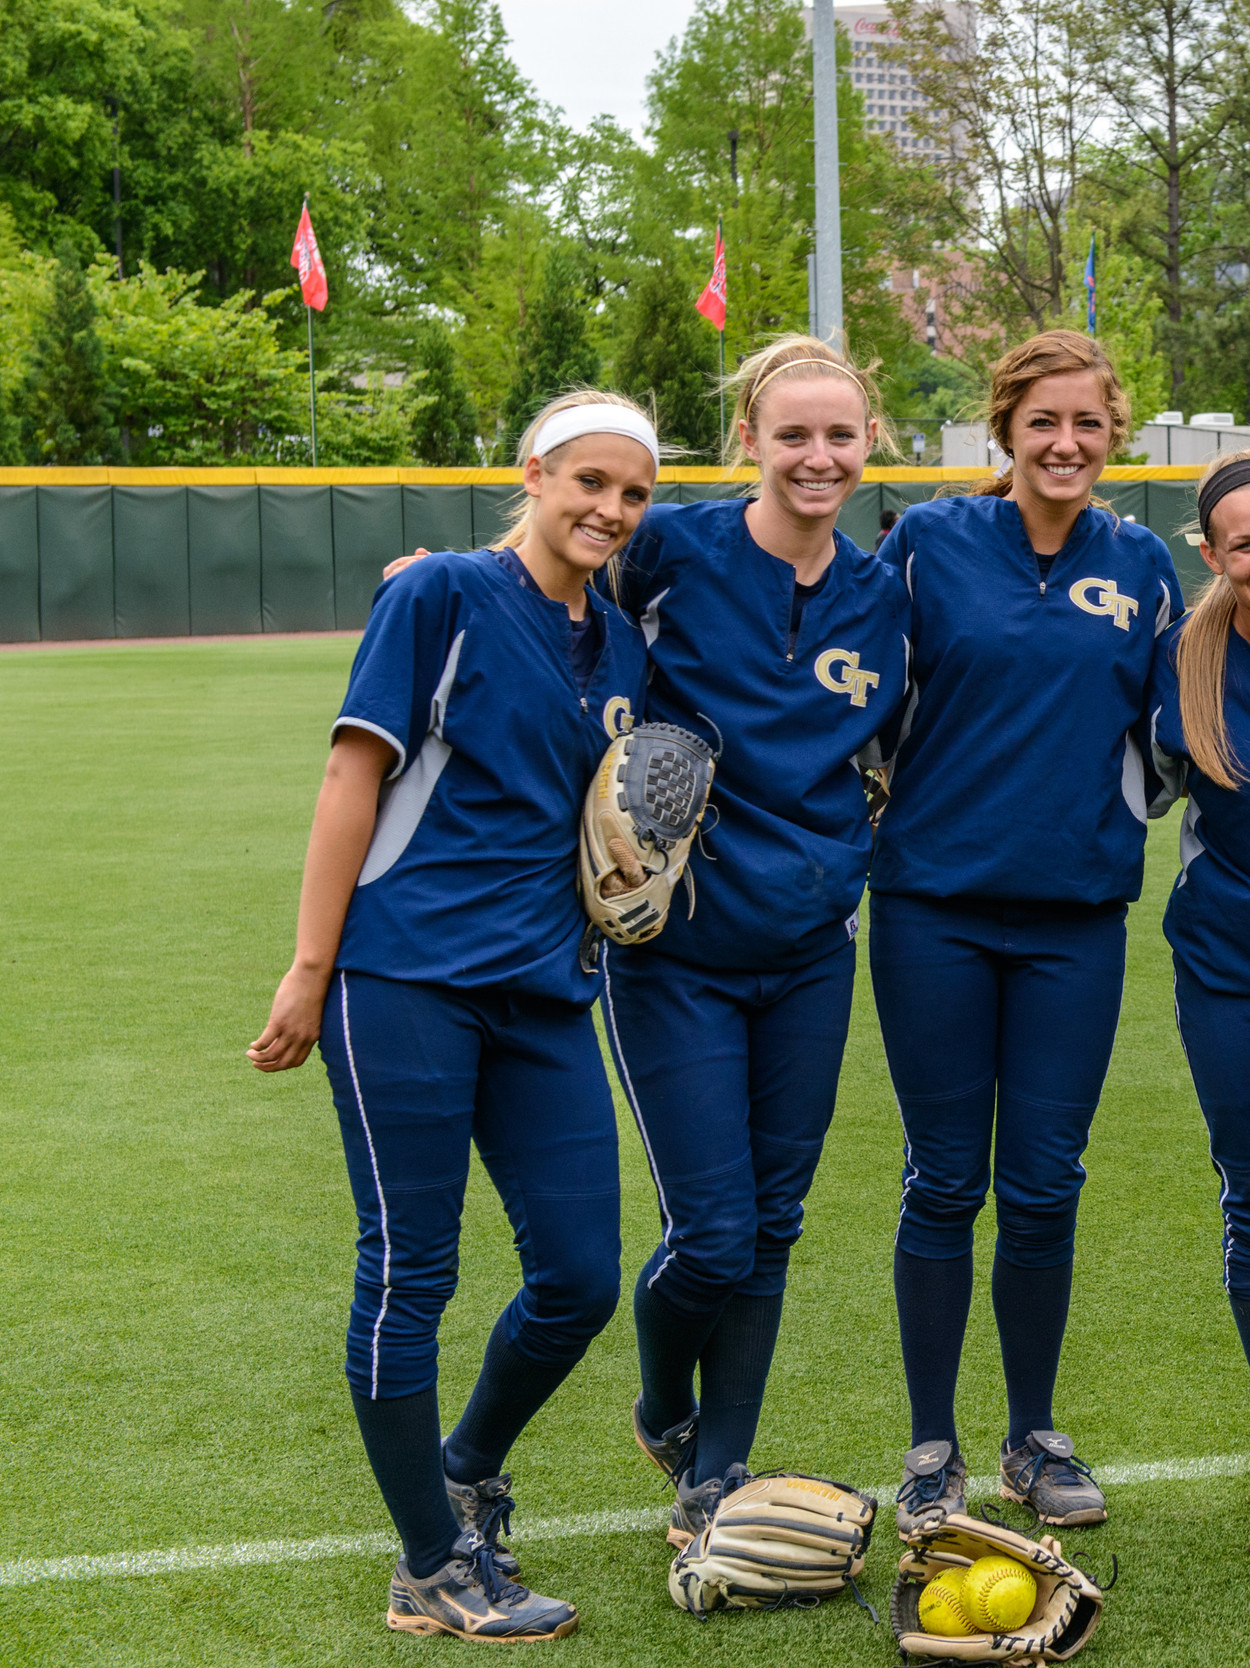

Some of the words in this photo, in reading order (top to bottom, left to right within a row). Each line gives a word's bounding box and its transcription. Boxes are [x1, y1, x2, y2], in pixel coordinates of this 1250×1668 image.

[1068, 577, 1139, 632] GT
[814, 647, 880, 708] GT
[786, 1479, 842, 1502] WORTH
